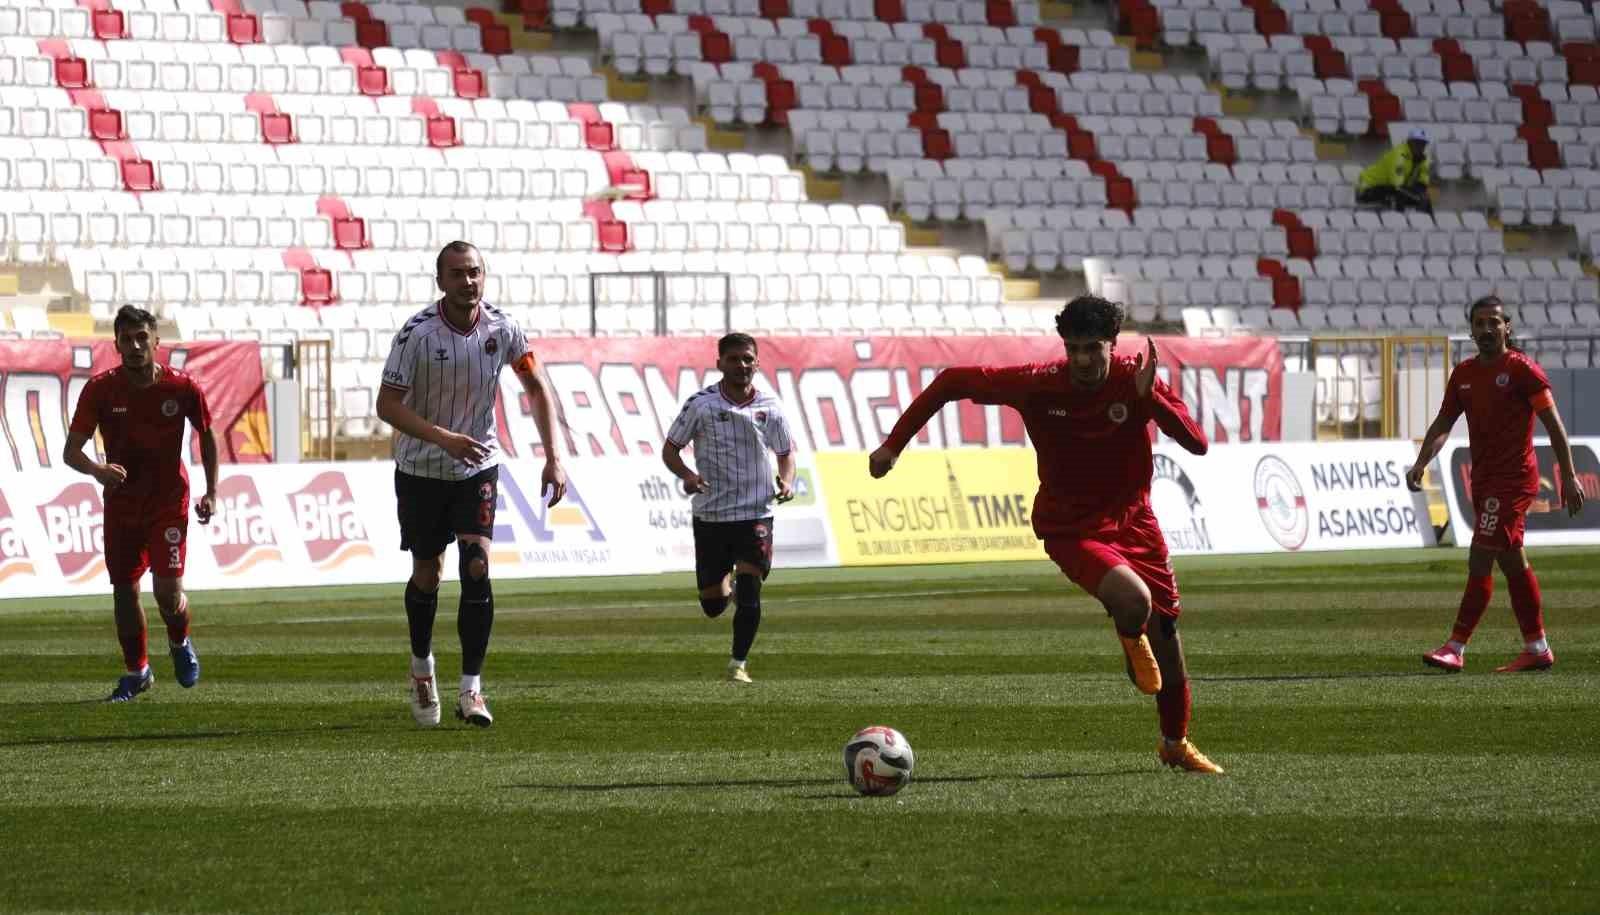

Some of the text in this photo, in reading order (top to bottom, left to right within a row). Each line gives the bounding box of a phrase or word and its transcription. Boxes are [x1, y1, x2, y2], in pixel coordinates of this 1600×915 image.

[1311, 460, 1401, 491] NAVHAS
[207, 500, 277, 546] Bifa
[294, 489, 369, 542] Bifa
[846, 493, 1032, 534] ENGLISH TIME
[1319, 499, 1419, 537] ASANSÖR
[1479, 511, 1499, 531] 92
[169, 545, 180, 562] 3
